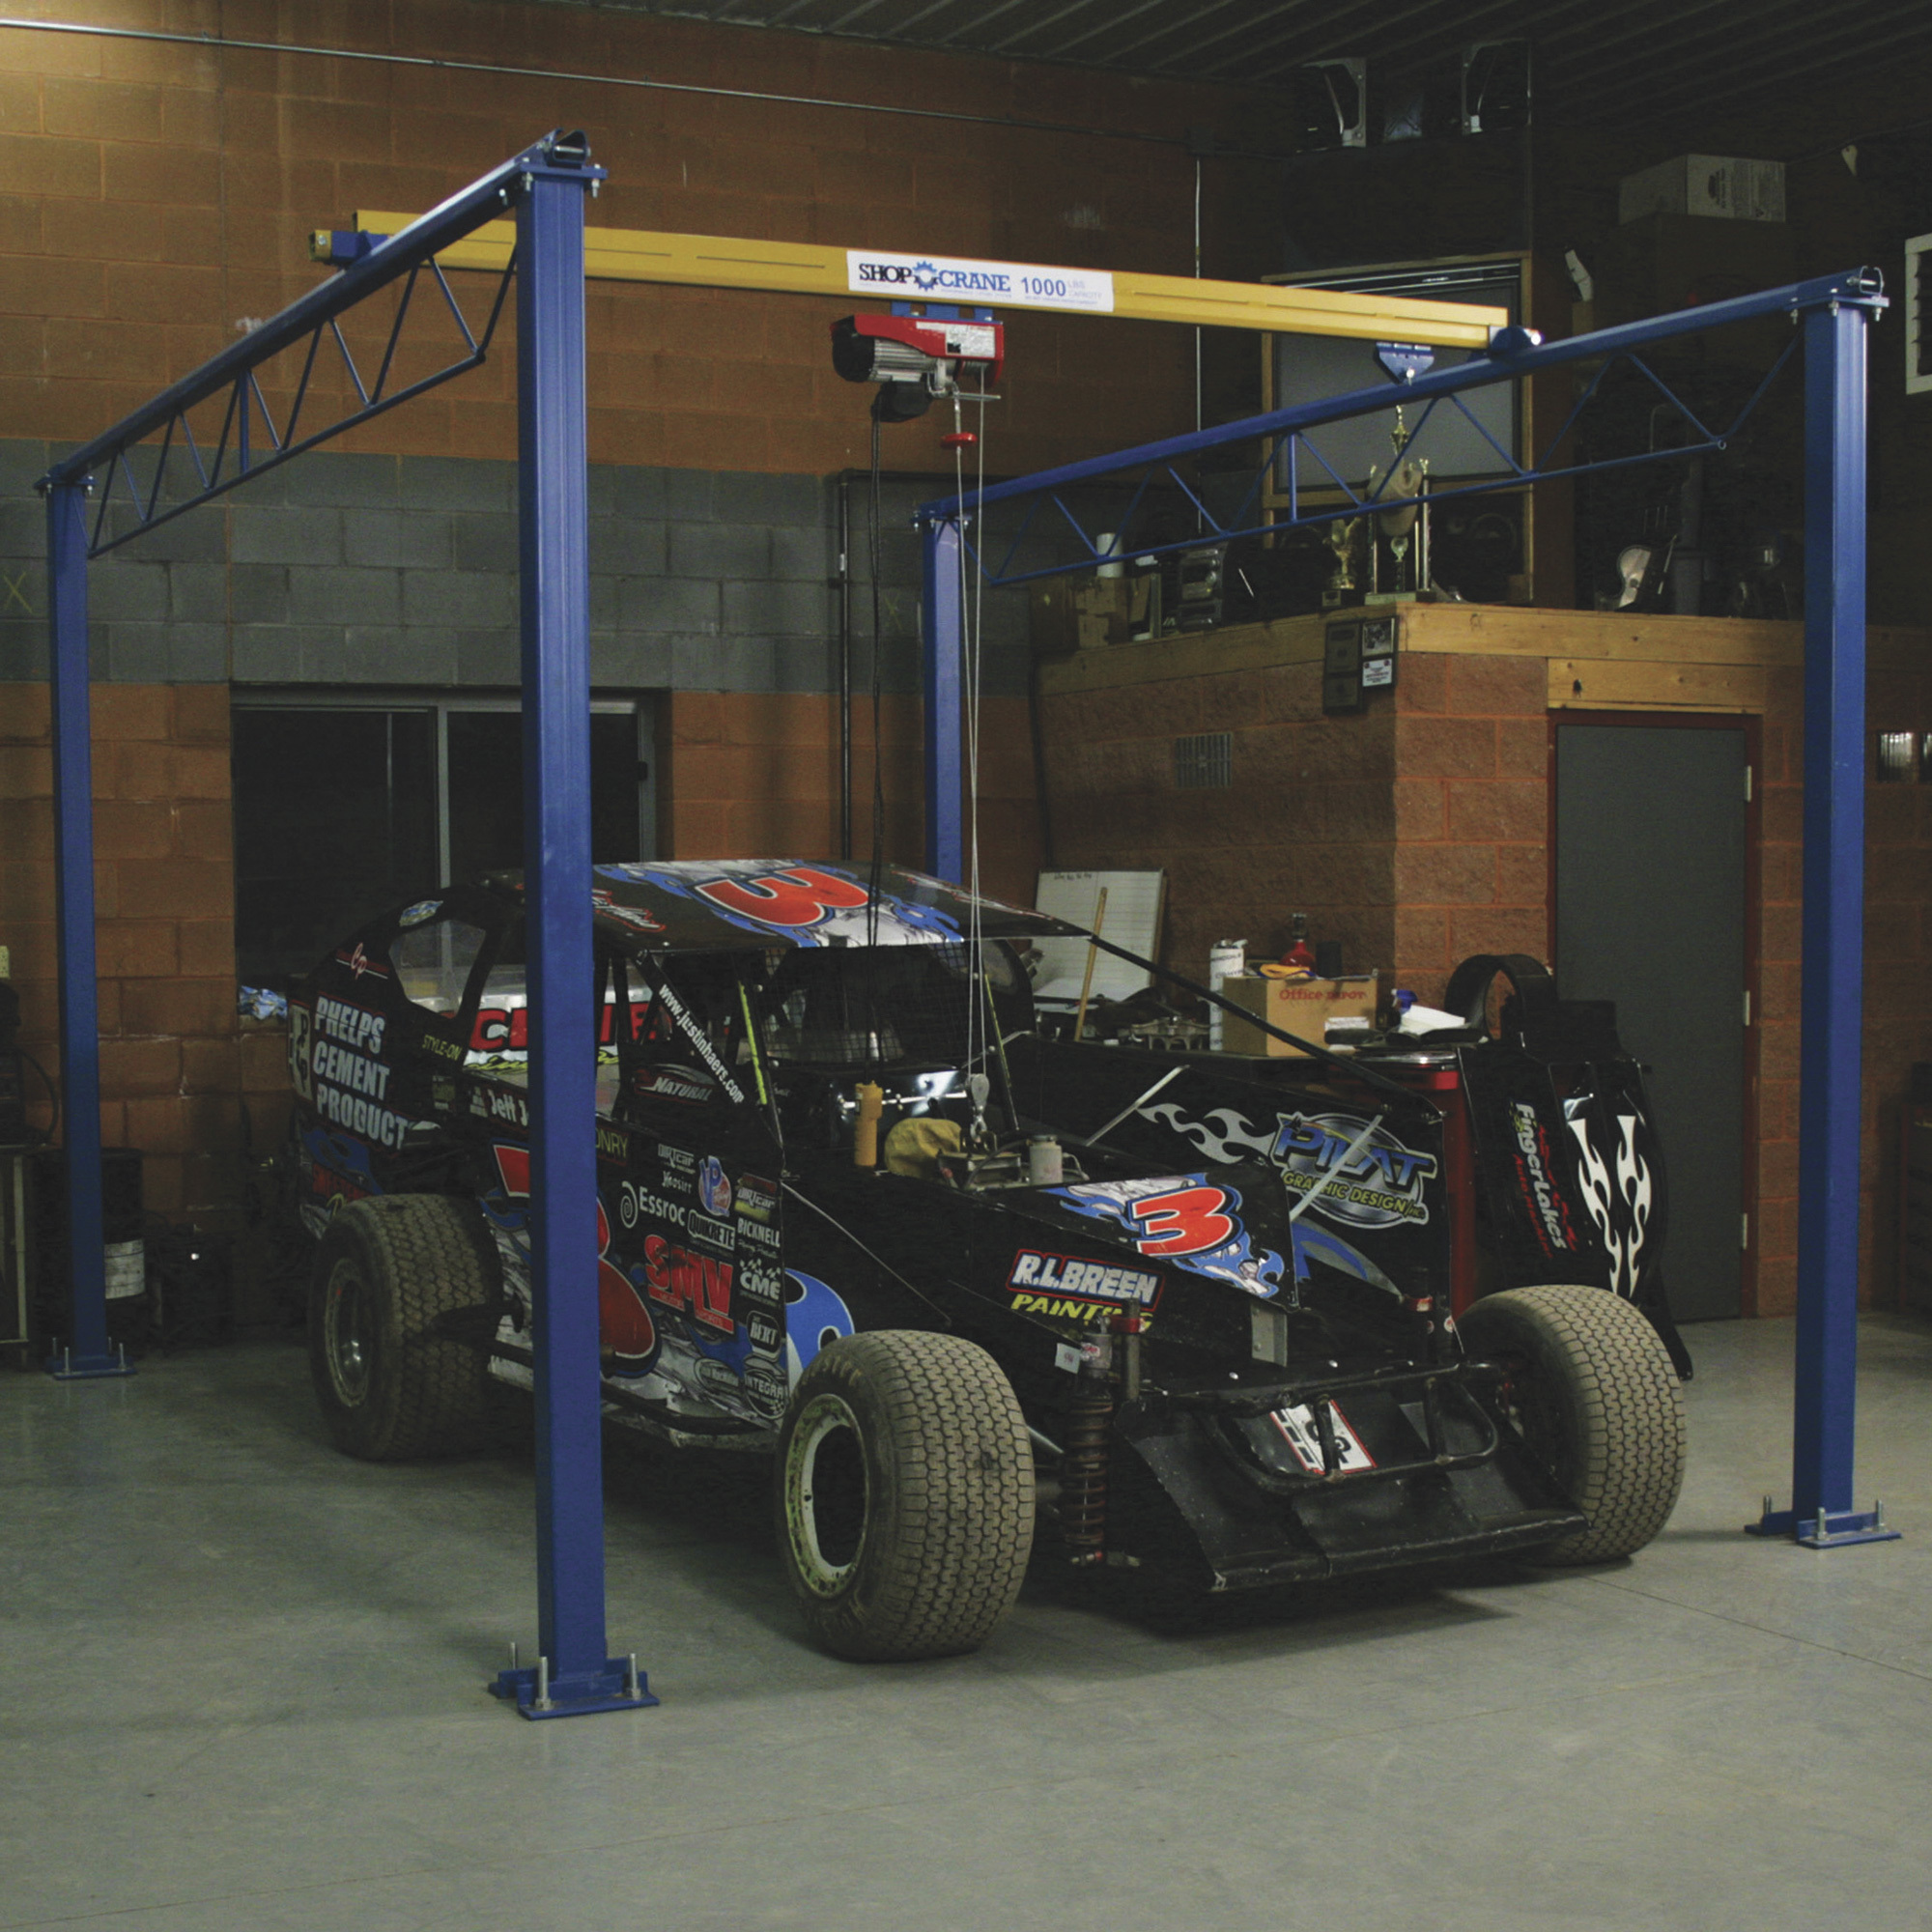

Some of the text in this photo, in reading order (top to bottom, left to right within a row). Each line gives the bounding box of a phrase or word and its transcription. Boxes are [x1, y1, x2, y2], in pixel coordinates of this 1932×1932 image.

[858, 263, 912, 284] SHOP
[937, 270, 1011, 292] CRANE
[1020, 276, 1066, 297] 1000
[694, 867, 870, 927] 3
[1278, 988, 1323, 1001] Office
[314, 996, 385, 1055] PHELPS
[658, 983, 746, 1103] www.justinhaers.com
[422, 1035, 463, 1062] STYLE-ON
[312, 1039, 391, 1101] CEMENT
[643, 1076, 714, 1102] NATURAL
[316, 1083, 409, 1151] PRODUCT
[1283, 1172, 1350, 1200] GRAHIC
[639, 1185, 686, 1227] Essroc
[1132, 1186, 1235, 1257] 3
[737, 1217, 781, 1248] BICKNELL
[739, 1270, 781, 1301] CME
